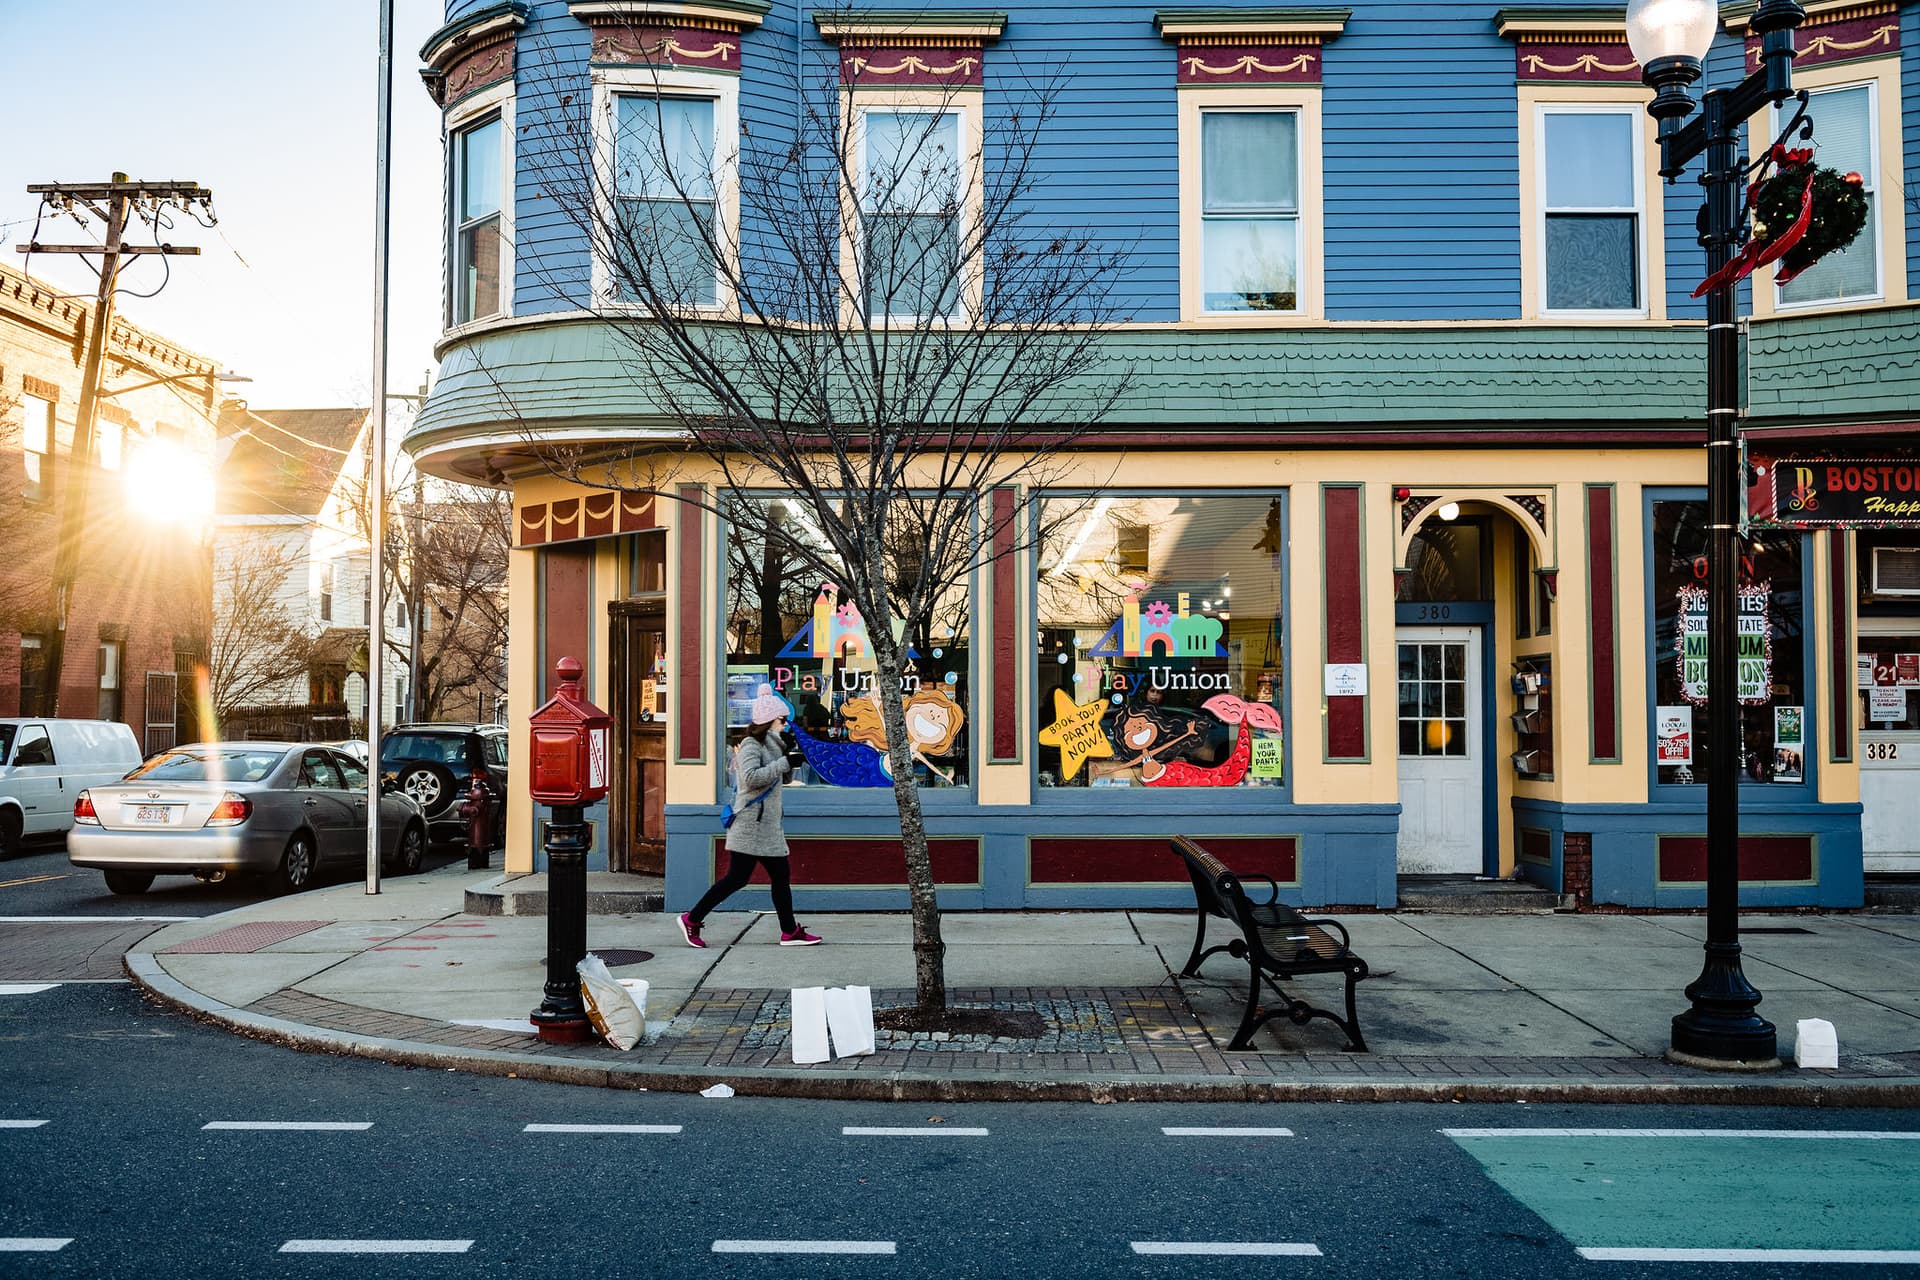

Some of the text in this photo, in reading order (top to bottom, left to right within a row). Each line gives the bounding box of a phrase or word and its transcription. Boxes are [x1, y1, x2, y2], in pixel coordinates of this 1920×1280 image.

[1693, 555, 1755, 579] ON
[1418, 605, 1450, 620] 380
[1686, 596, 1765, 612] CIGTES
[1687, 637, 1763, 655] MIUM
[774, 665, 921, 697] Play Unn
[1086, 664, 1232, 697] Play Union
[1686, 660, 1766, 683] BOON
[1877, 665, 1897, 681] 21
[1049, 703, 1101, 734] BOOK YOUR
[1062, 719, 1095, 745] PARTY
[1067, 728, 1104, 761] NOW!
[1256, 750, 1277, 758] YOUR
[1867, 743, 1897, 760] 382
[1255, 758, 1280, 766] PANTS
